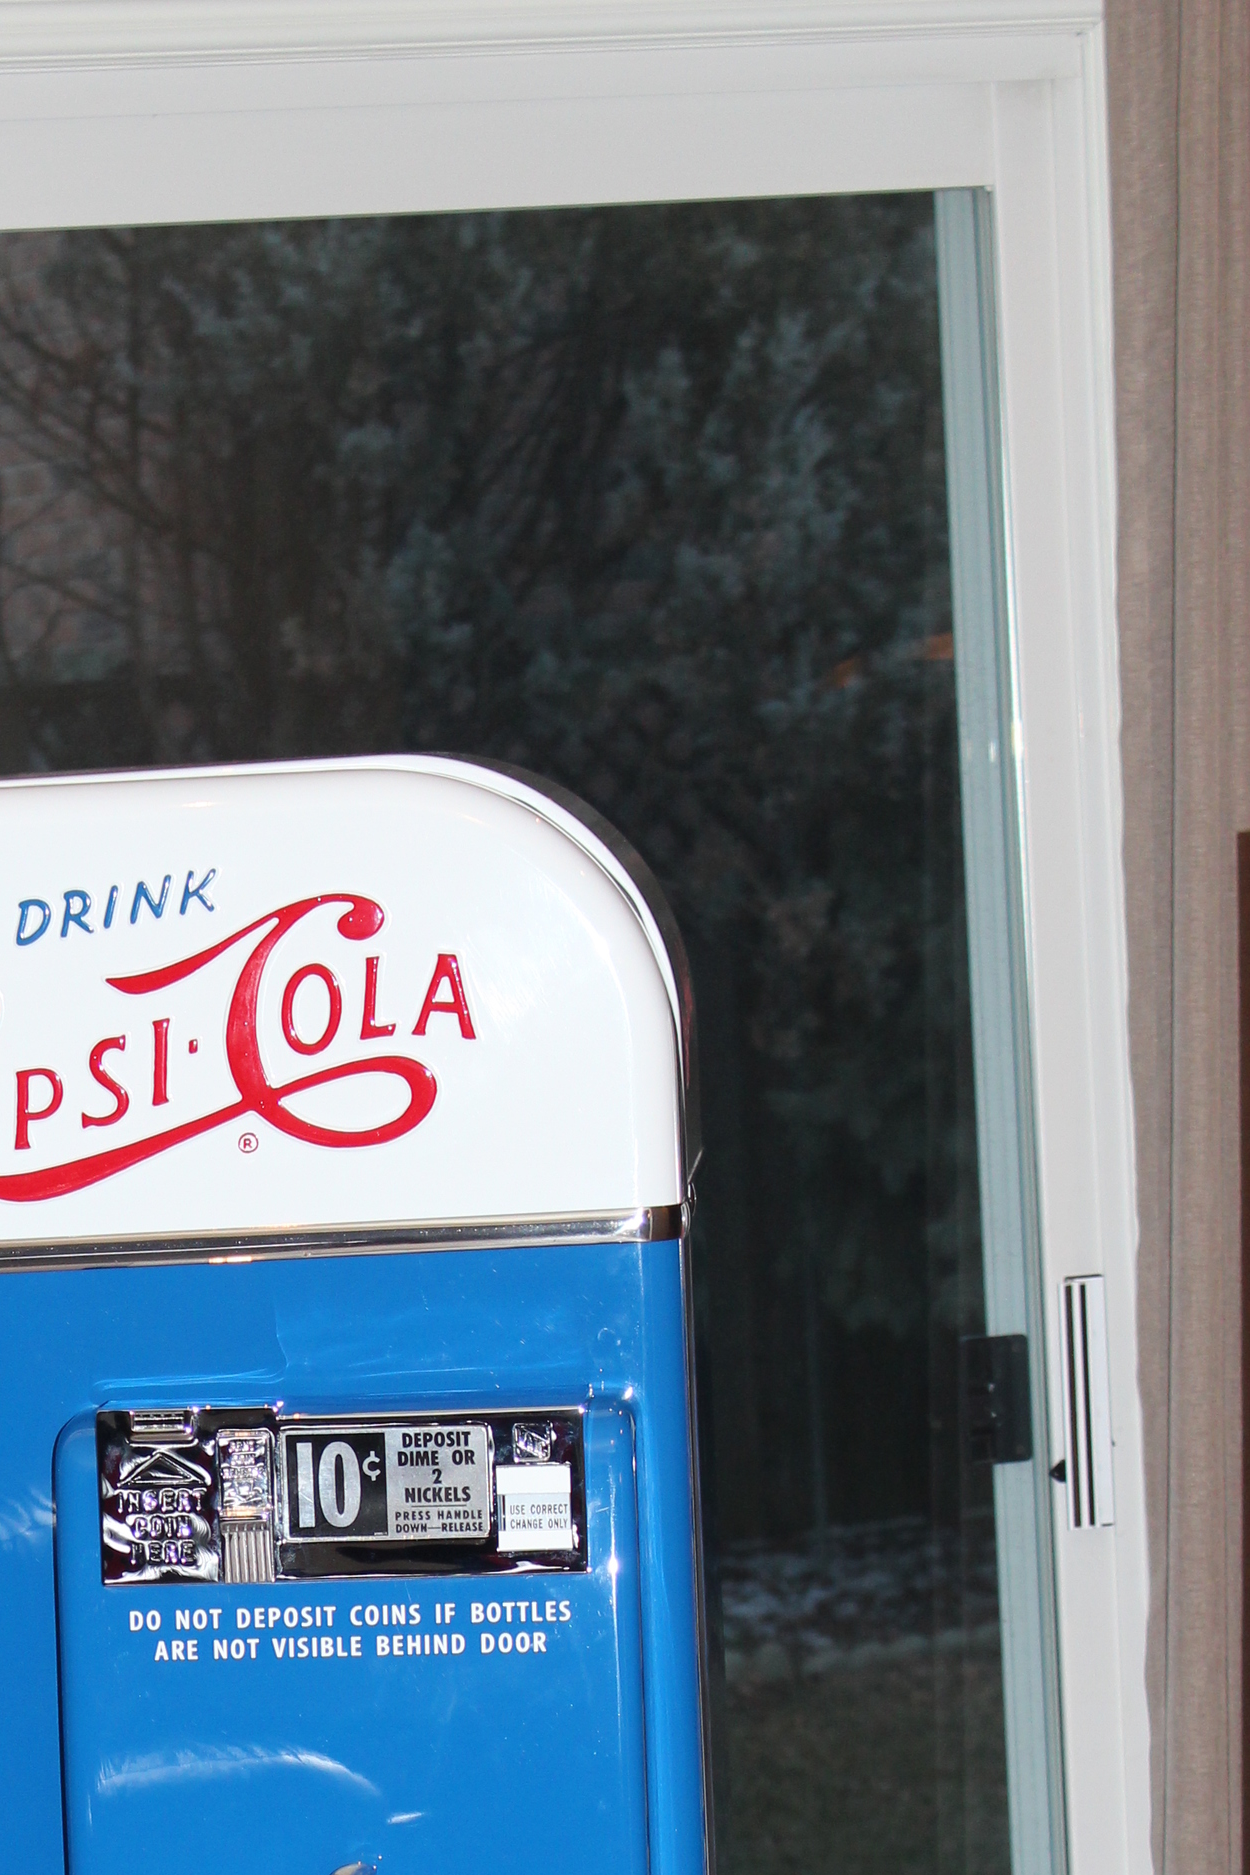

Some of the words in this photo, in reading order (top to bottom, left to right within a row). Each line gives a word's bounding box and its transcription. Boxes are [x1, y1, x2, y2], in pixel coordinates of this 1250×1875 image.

[16, 867, 219, 948] DRINK
[402, 1431, 472, 1448] DEPOSIT
[398, 1450, 440, 1466] DIME
[452, 1450, 476, 1466] OR
[432, 1469, 442, 1484] 2
[114, 1488, 207, 1512] INSERT
[404, 1486, 471, 1503] NICKELS
[395, 1510, 431, 1520] PRESS
[437, 1510, 483, 1520] HANDLE
[510, 1505, 526, 1515] USE
[530, 1504, 568, 1515] CORRECT
[133, 1515, 192, 1537] COIN
[510, 1518, 544, 1529] CHANGE
[548, 1518, 568, 1529] ONLY
[130, 1541, 195, 1564] HERE
[129, 1610, 162, 1632] DO
[175, 1608, 223, 1630] NOT
[236, 1606, 337, 1629] DEPOSIT
[349, 1603, 421, 1626] COINS
[435, 1603, 455, 1624] IF
[470, 1600, 571, 1624] BOTTLES
[154, 1640, 198, 1662] ARE
[212, 1638, 260, 1660] NOT
[272, 1635, 362, 1659] VISIBLE
[376, 1633, 466, 1657] BEHIND
[480, 1632, 547, 1654] DOOR
